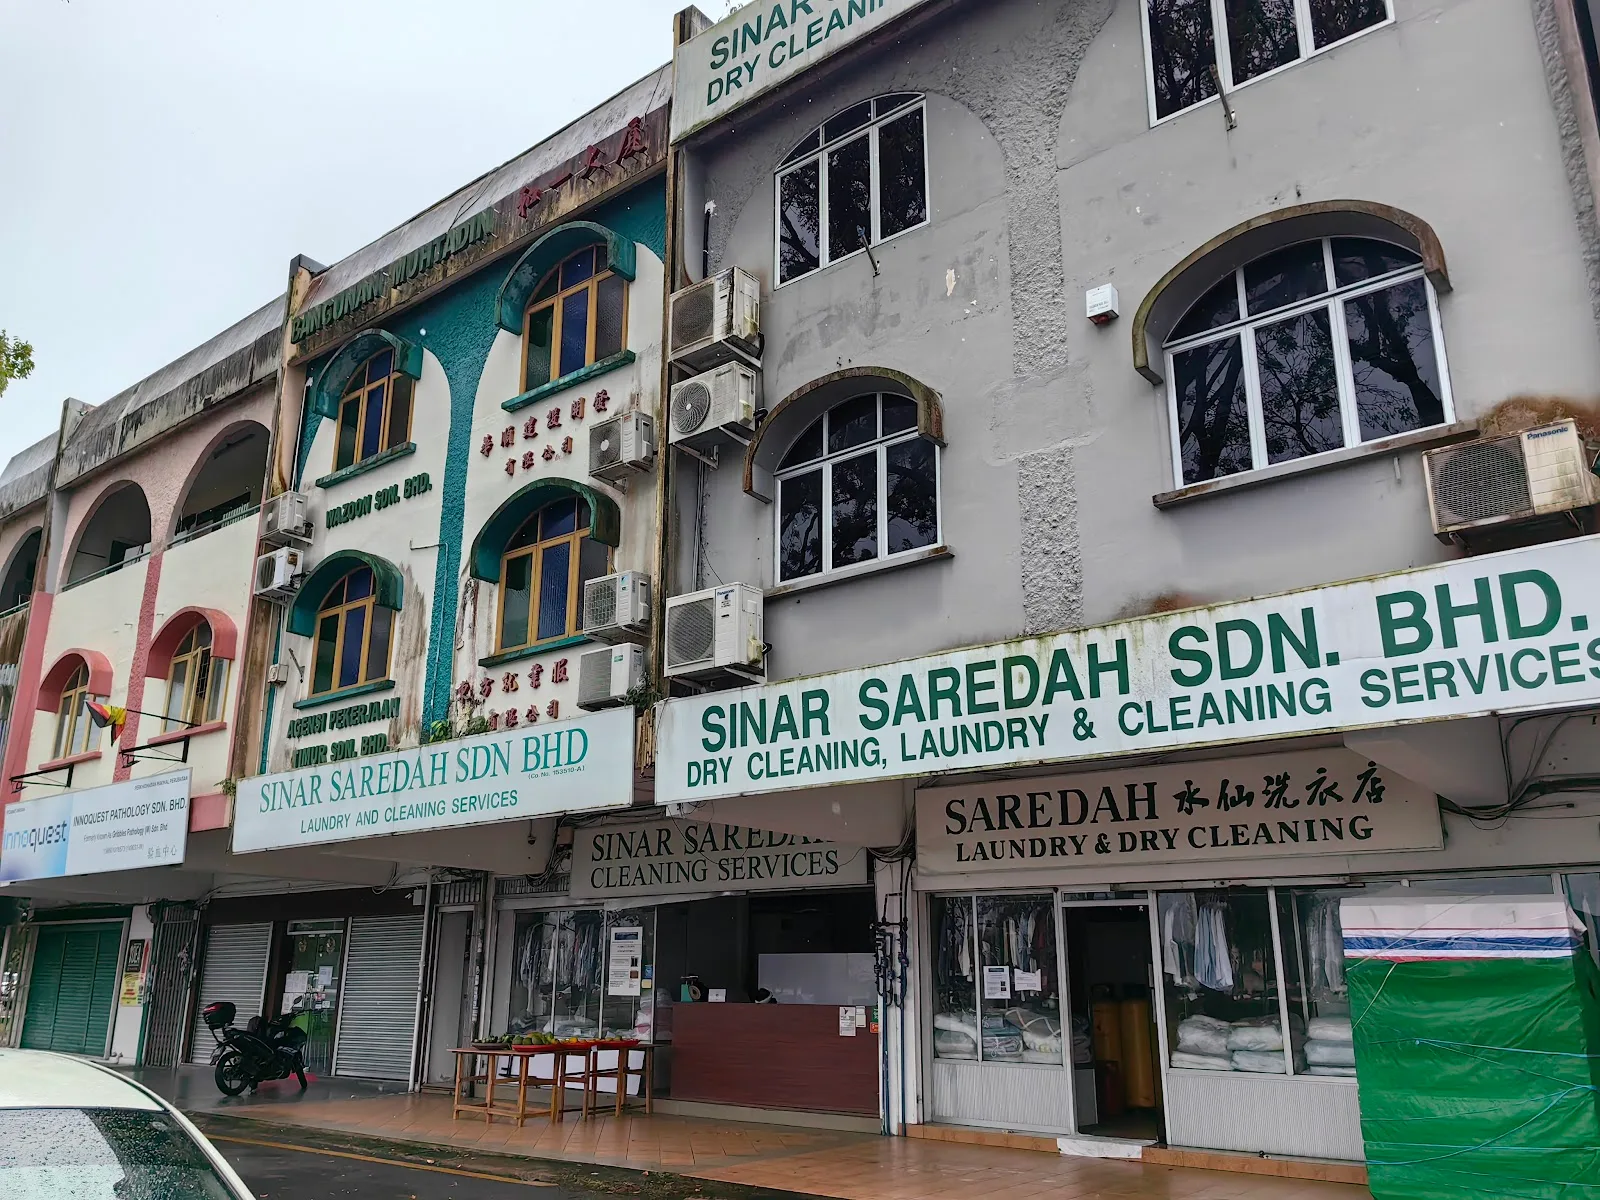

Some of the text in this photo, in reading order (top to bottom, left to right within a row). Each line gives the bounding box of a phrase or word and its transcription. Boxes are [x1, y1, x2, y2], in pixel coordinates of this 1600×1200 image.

[707, 54, 760, 106] DRY
[290, 206, 494, 344] BANGUNAN MUHTADIN
[1527, 426, 1569, 440] Panasonic
[504, 435, 573, 476] 有限公司
[374, 484, 401, 511] SDN.
[403, 472, 432, 499] BHD.
[701, 568, 1588, 752] SINAR SAREDAH SDN. BHD.
[287, 697, 400, 739] AGENSI PEKERJAAN
[487, 699, 559, 730] 有限公司
[687, 756, 733, 788] DRY
[747, 736, 887, 781] CLEANING,
[900, 713, 1049, 762] LAUNDRY
[1073, 706, 1095, 741] &
[1118, 677, 1332, 737] CLEANING
[259, 728, 588, 814] SINAR SAREDAH SDN BHD
[293, 733, 390, 768] TIMUR SDN. BHD.
[73, 797, 187, 827] INNOQUEST PATHOLOGY SDN. BHD.
[300, 789, 518, 834] LAUNDRY AND CLEANING SERVICES
[945, 761, 1386, 835] SAREDAH 水仙洗衣店
[3, 820, 67, 853] innoquest
[591, 823, 836, 862] SINAR SARED
[956, 815, 1374, 863] LAUNDRY & DRY CLEANING
[590, 850, 839, 889] CLEANING SERVICES
